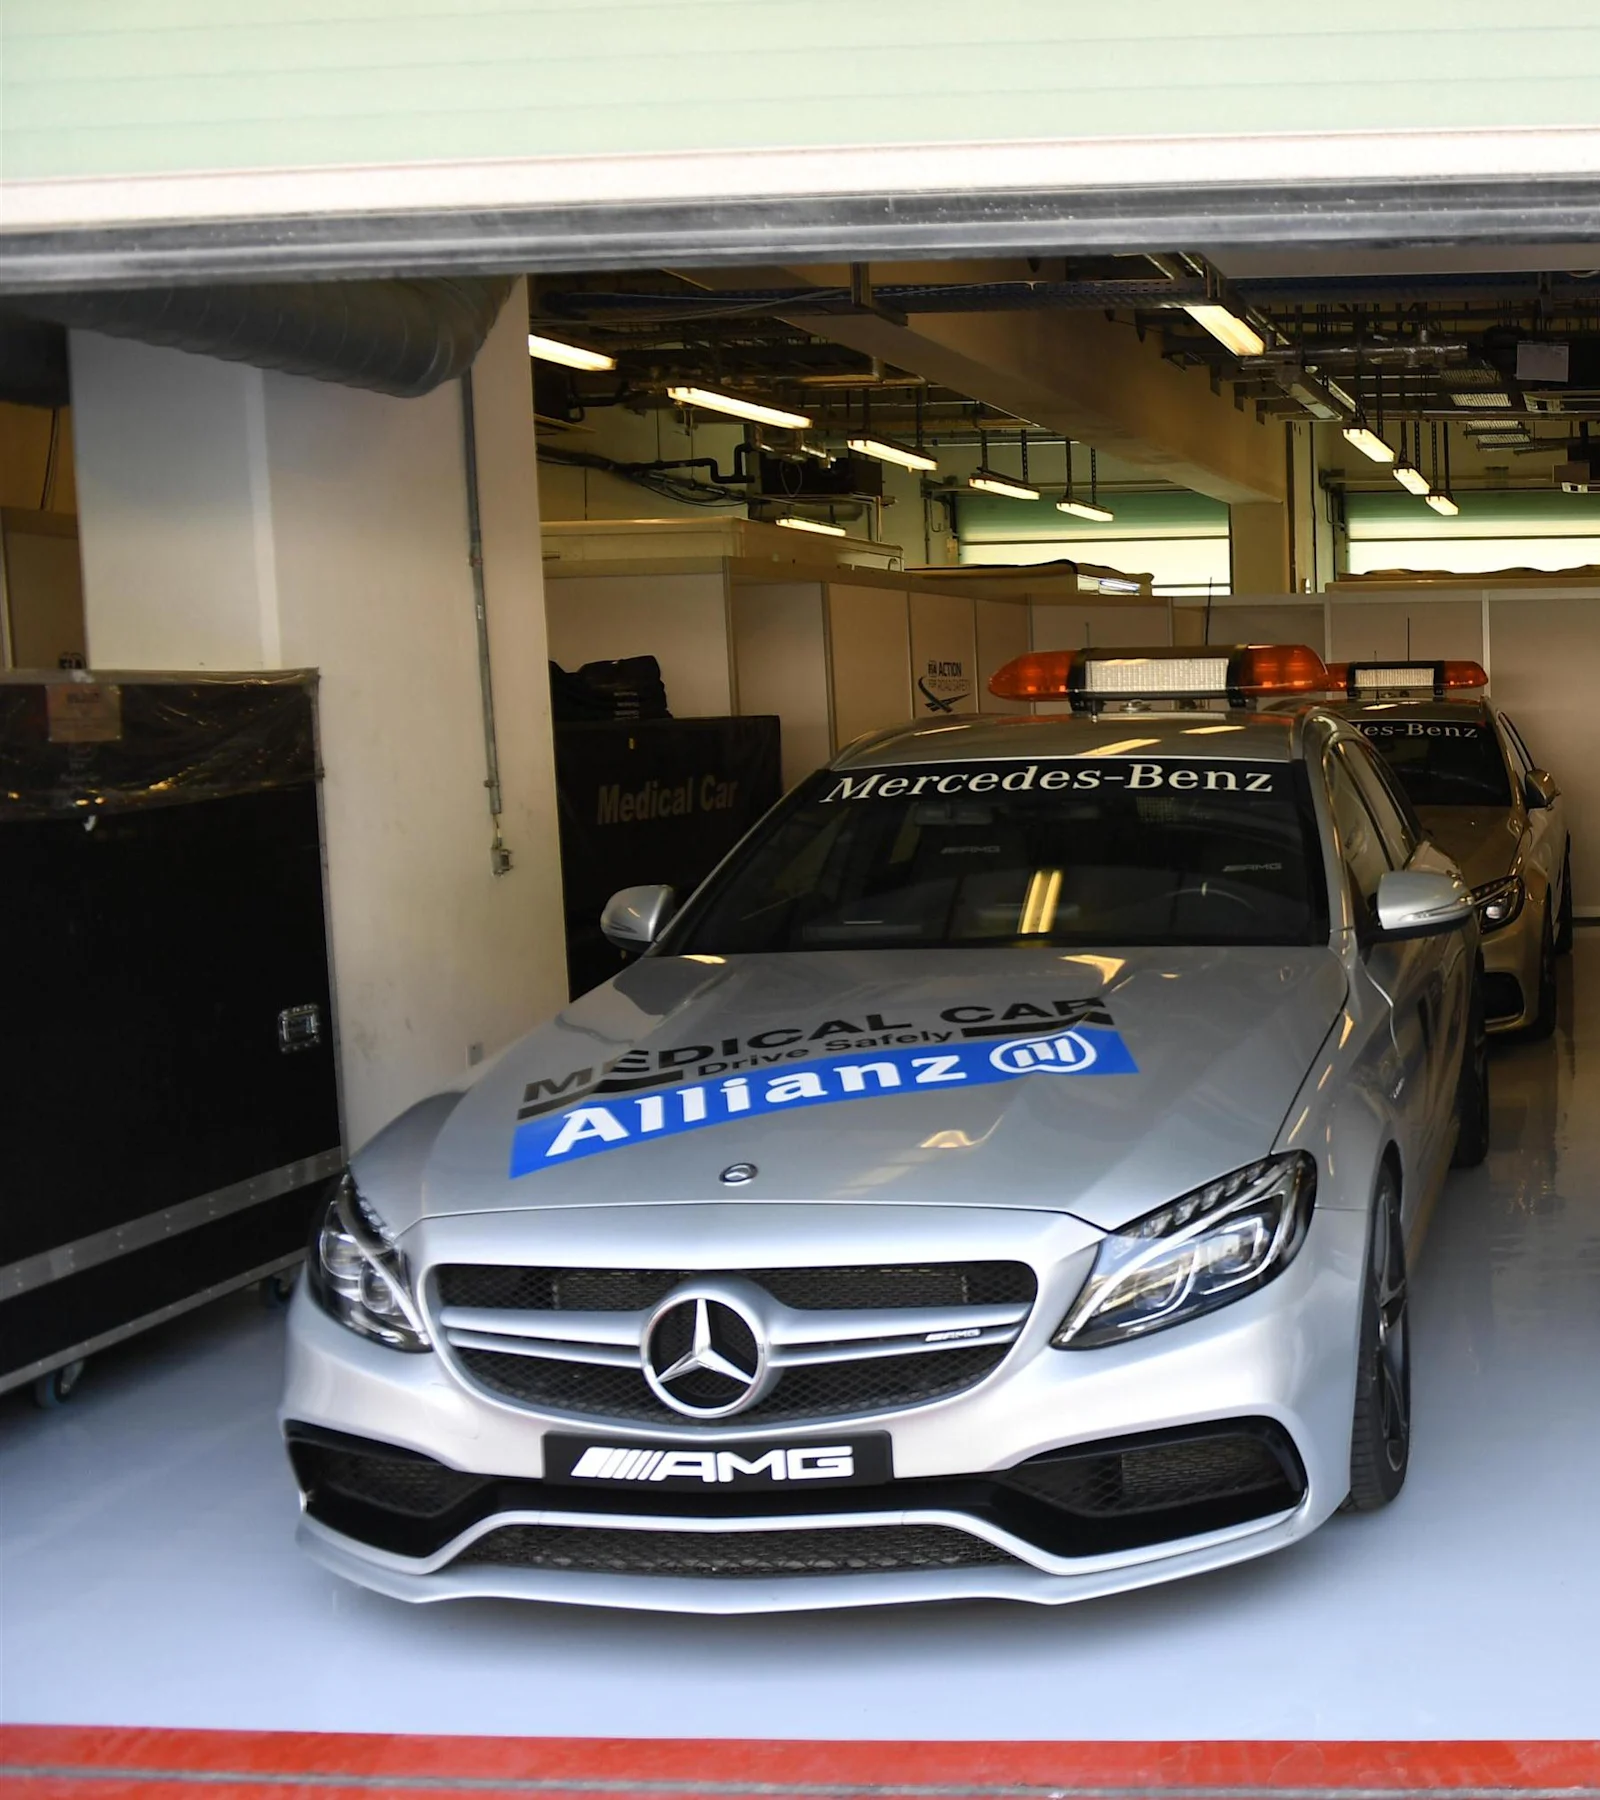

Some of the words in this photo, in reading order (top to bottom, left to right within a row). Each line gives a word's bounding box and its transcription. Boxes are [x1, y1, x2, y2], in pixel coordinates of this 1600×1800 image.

[938, 661, 962, 677] ACTION
[1354, 722, 1478, 738] es-Benz
[597, 777, 693, 825] Medical
[701, 774, 739, 812] Car
[819, 763, 1274, 803] Mercedes-Benz
[522, 1014, 913, 1103] MEDICAL
[940, 997, 1106, 1024] CAR
[698, 1049, 810, 1076] Drive
[826, 1029, 953, 1053] Safely
[545, 1054, 967, 1157] Allianz
[648, 1446, 854, 1483] AMG
